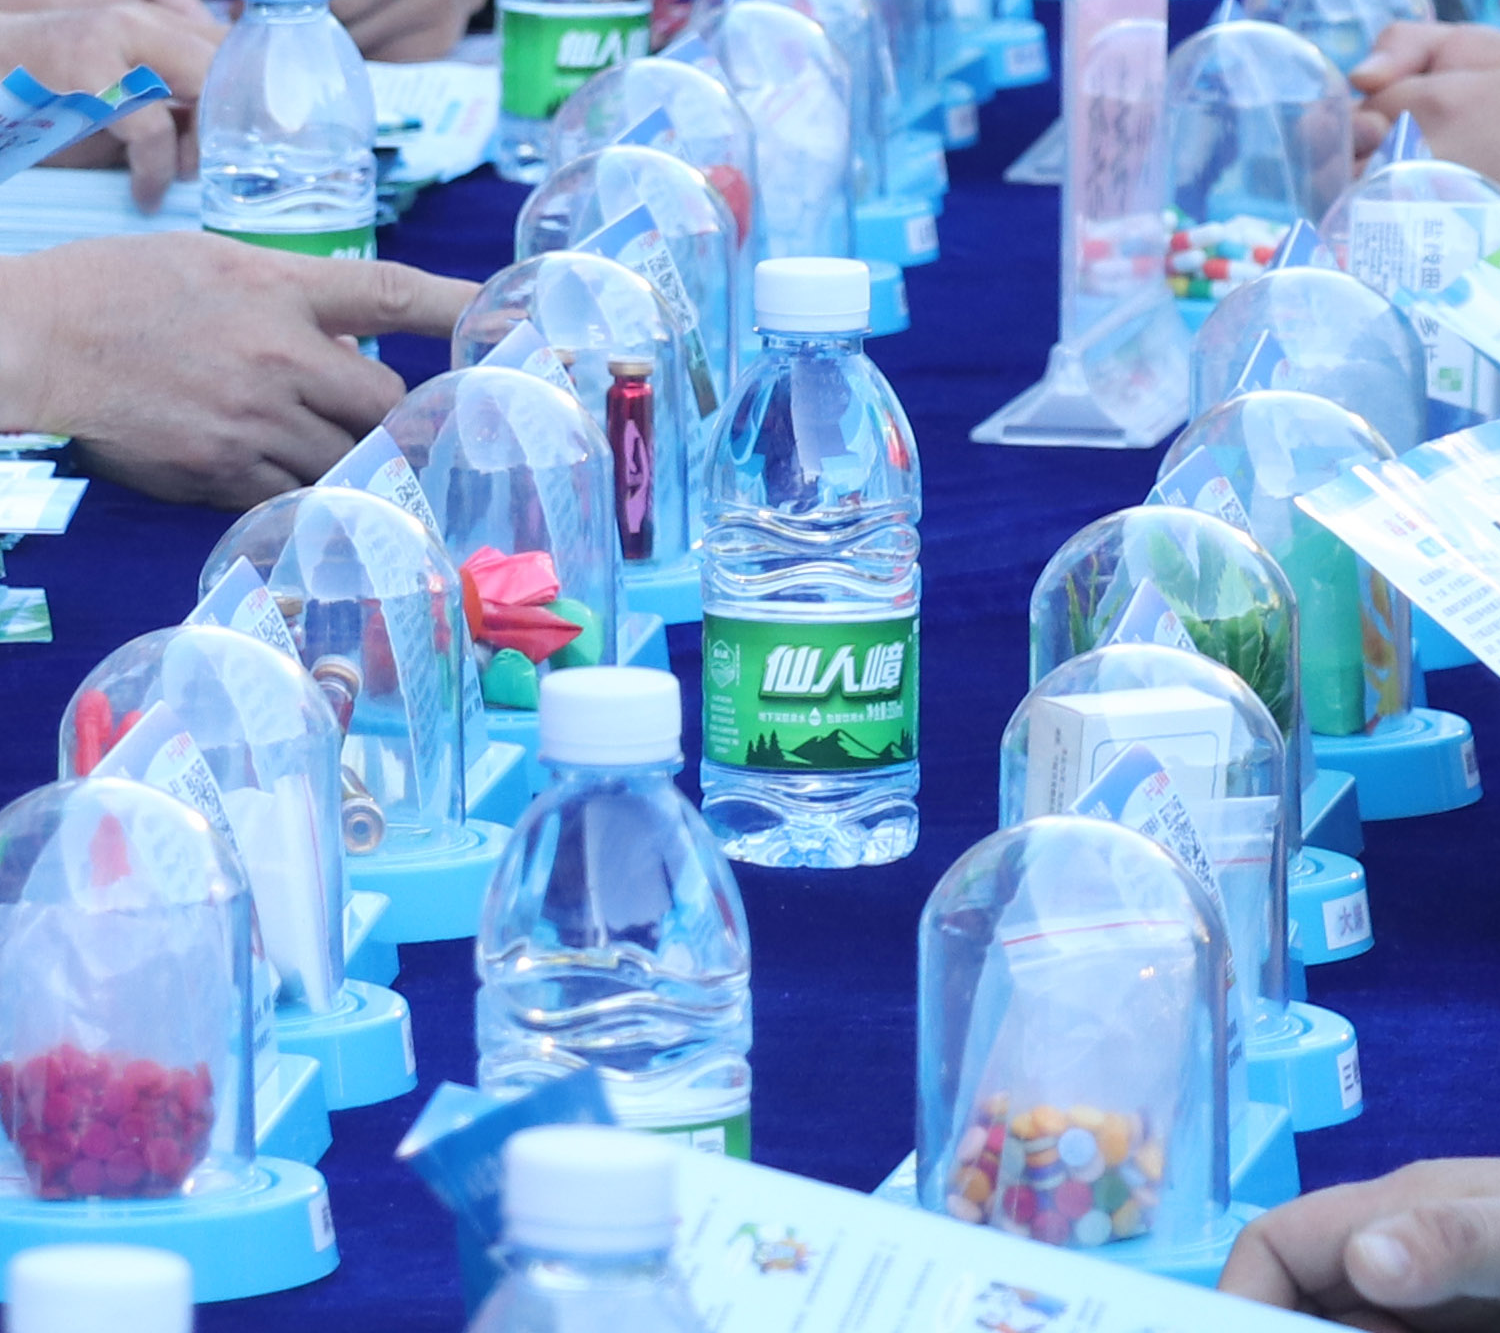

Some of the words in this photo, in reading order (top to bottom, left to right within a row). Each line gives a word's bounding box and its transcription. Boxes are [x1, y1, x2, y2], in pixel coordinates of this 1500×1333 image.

[1419, 218, 1444, 362] 盐酸曲多片
[762, 644, 905, 693] 仙人嶂
